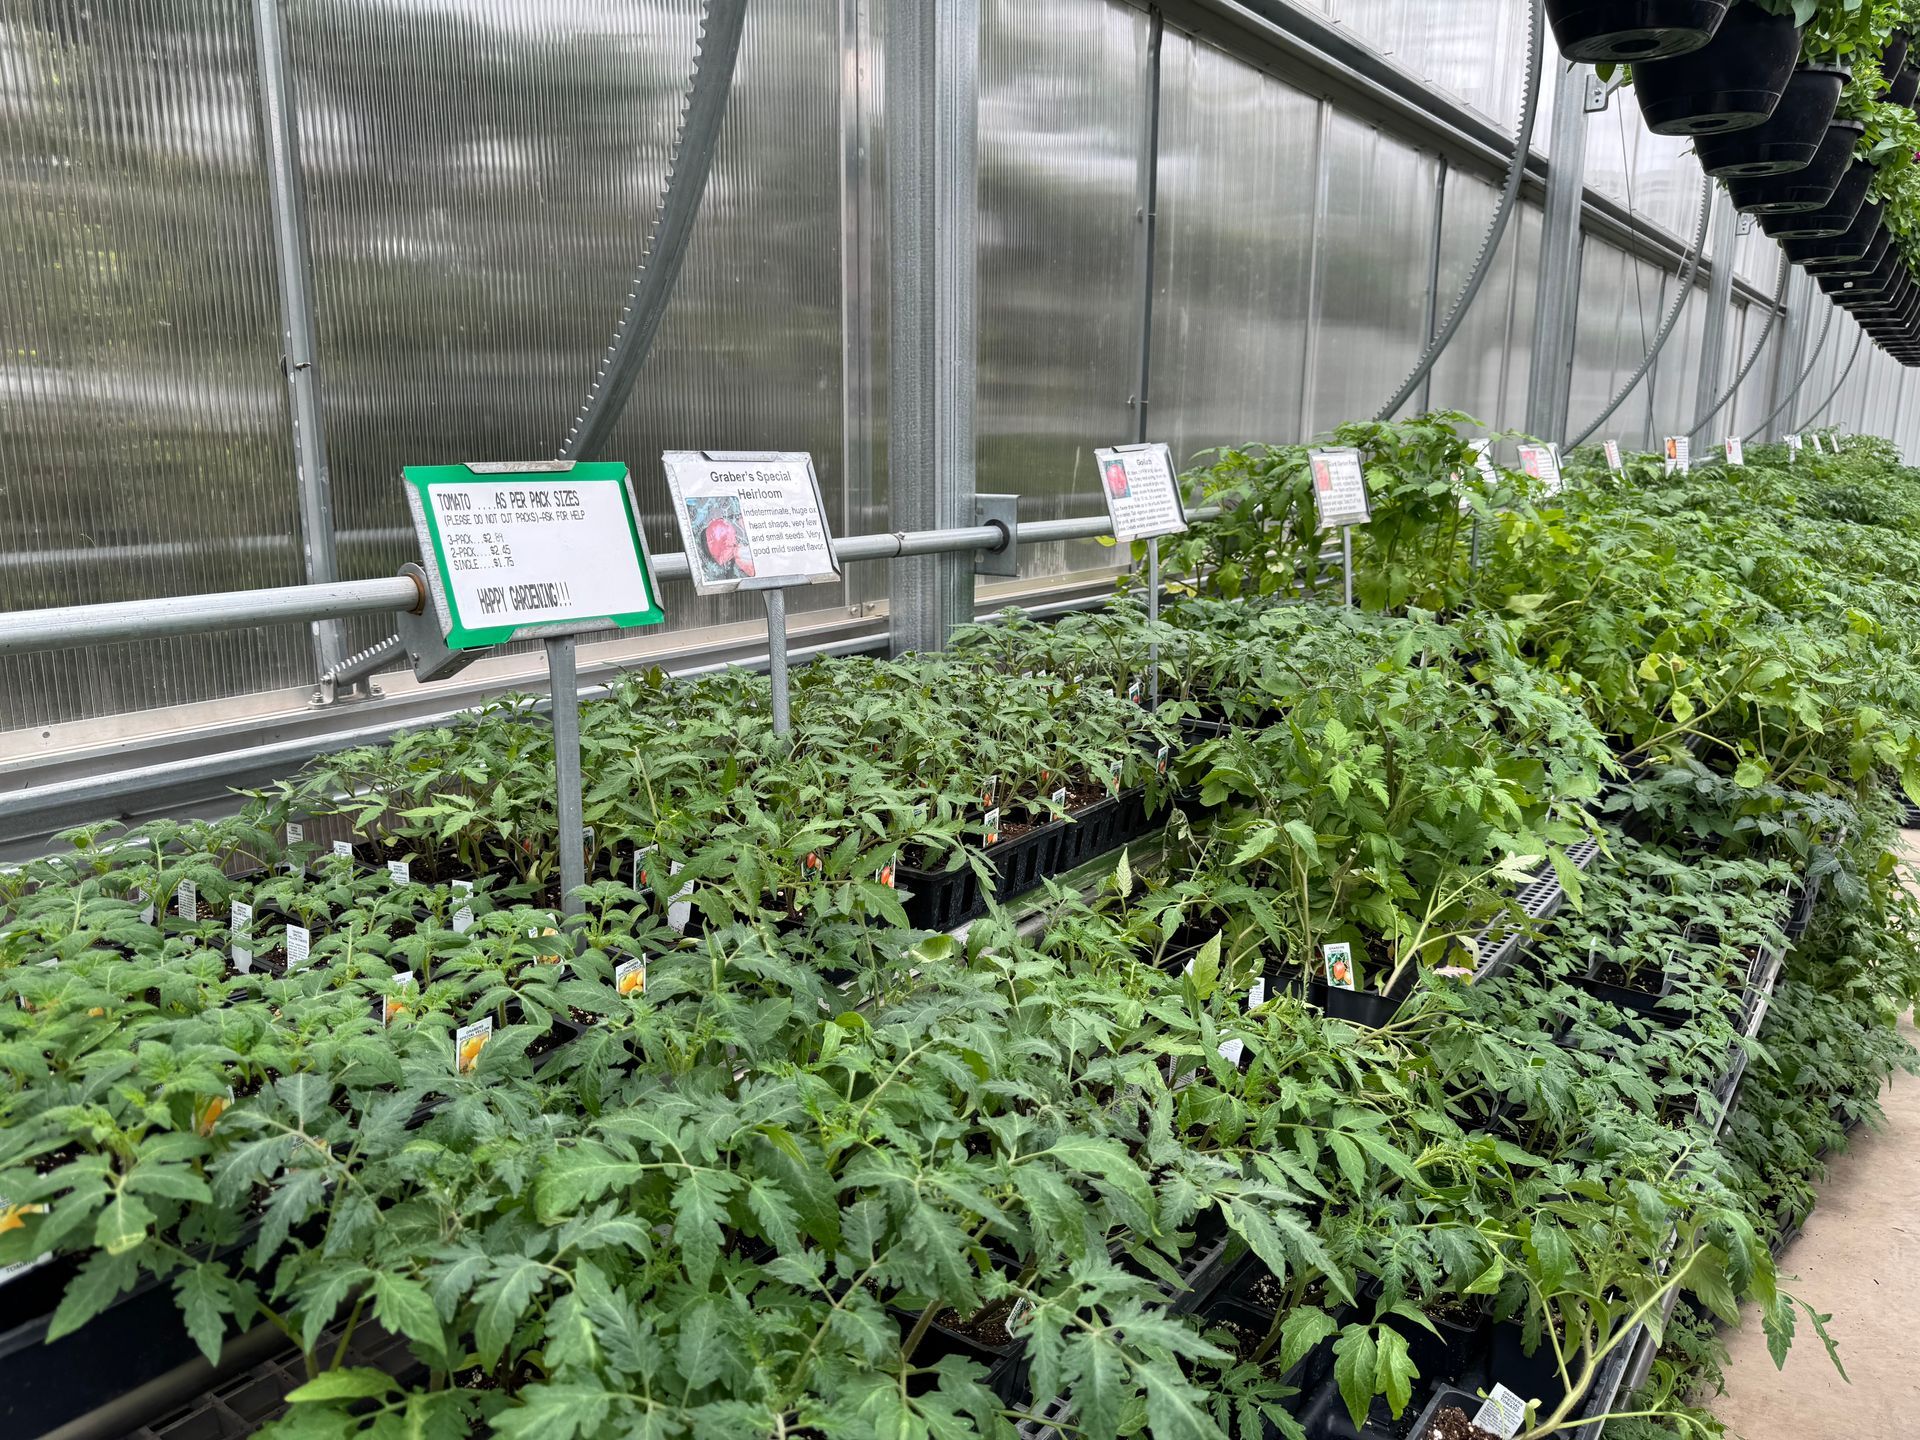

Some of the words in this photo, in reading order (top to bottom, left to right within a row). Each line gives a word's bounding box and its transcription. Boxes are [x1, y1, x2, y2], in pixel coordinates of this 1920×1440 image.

[710, 471, 755, 483] Graber's
[756, 470, 792, 484] Special
[437, 493, 472, 511] TOMATO
[510, 491, 527, 509] PER
[529, 490, 551, 509] PACK
[554, 490, 580, 507] SIZES
[737, 488, 783, 500] Heirloom
[444, 515, 472, 527] (PLEASE
[474, 514, 484, 525] DO
[485, 513, 497, 525] NOT
[500, 513, 513, 523] CUT
[556, 511, 568, 521] FOR
[571, 510, 585, 520] HELP
[743, 507, 792, 517] Indeterminate,
[791, 507, 808, 516] huge
[749, 521, 767, 530] heart
[768, 520, 791, 529] shape,
[791, 521, 805, 530] very
[805, 518, 817, 526] few
[752, 534, 765, 543] and
[765, 532, 784, 541] small
[806, 530, 821, 540] Very
[753, 547, 770, 557] good
[771, 545, 786, 554] mild
[787, 544, 806, 553] sweet
[477, 586, 508, 615] HAPPY
[509, 582, 572, 611] GARDENING!!!
[1500, 1397, 1518, 1412] TOMATO
[1501, 1394, 1520, 1409] SPECIAL
